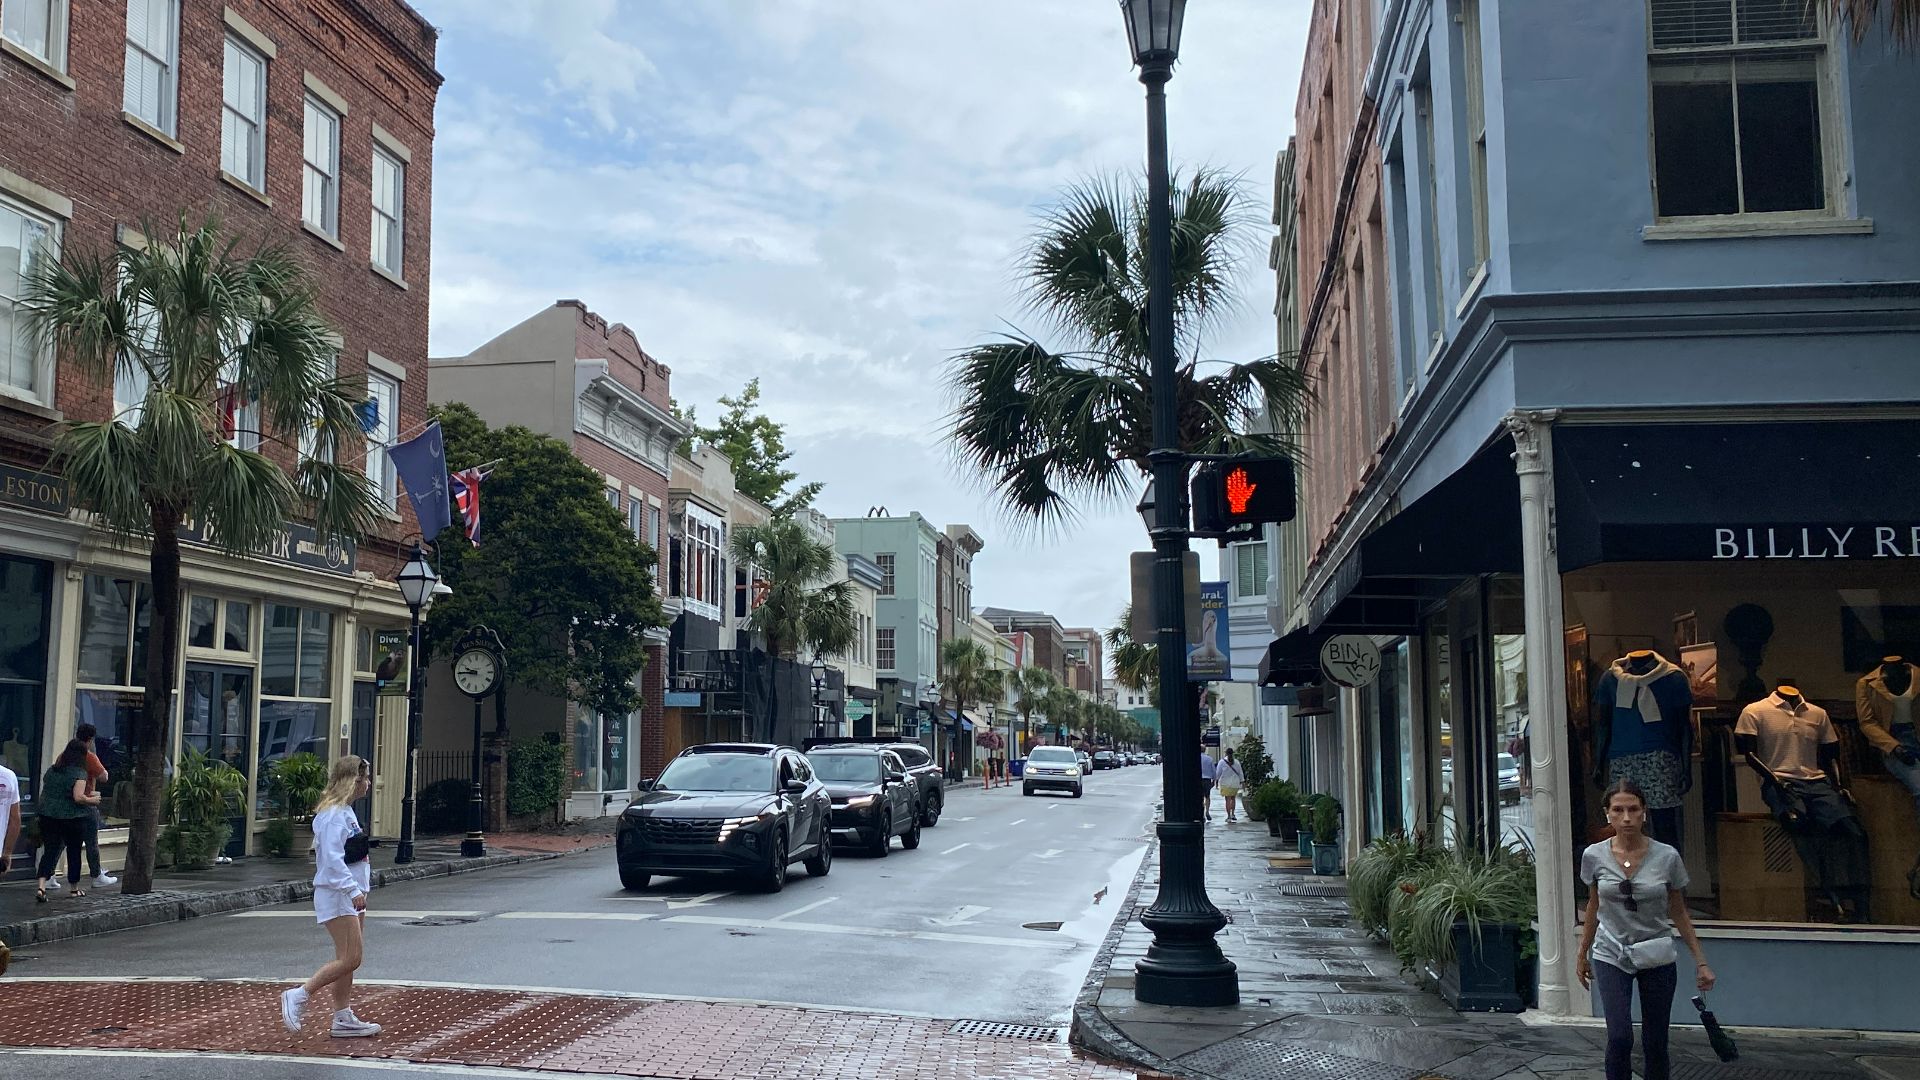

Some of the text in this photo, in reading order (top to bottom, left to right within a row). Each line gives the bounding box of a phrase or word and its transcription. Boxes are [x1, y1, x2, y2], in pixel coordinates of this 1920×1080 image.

[0, 476, 62, 505] ESTON
[1712, 527, 1855, 559] BILLY
[379, 635, 402, 644] Dive.
[1329, 642, 1361, 662] BIN
